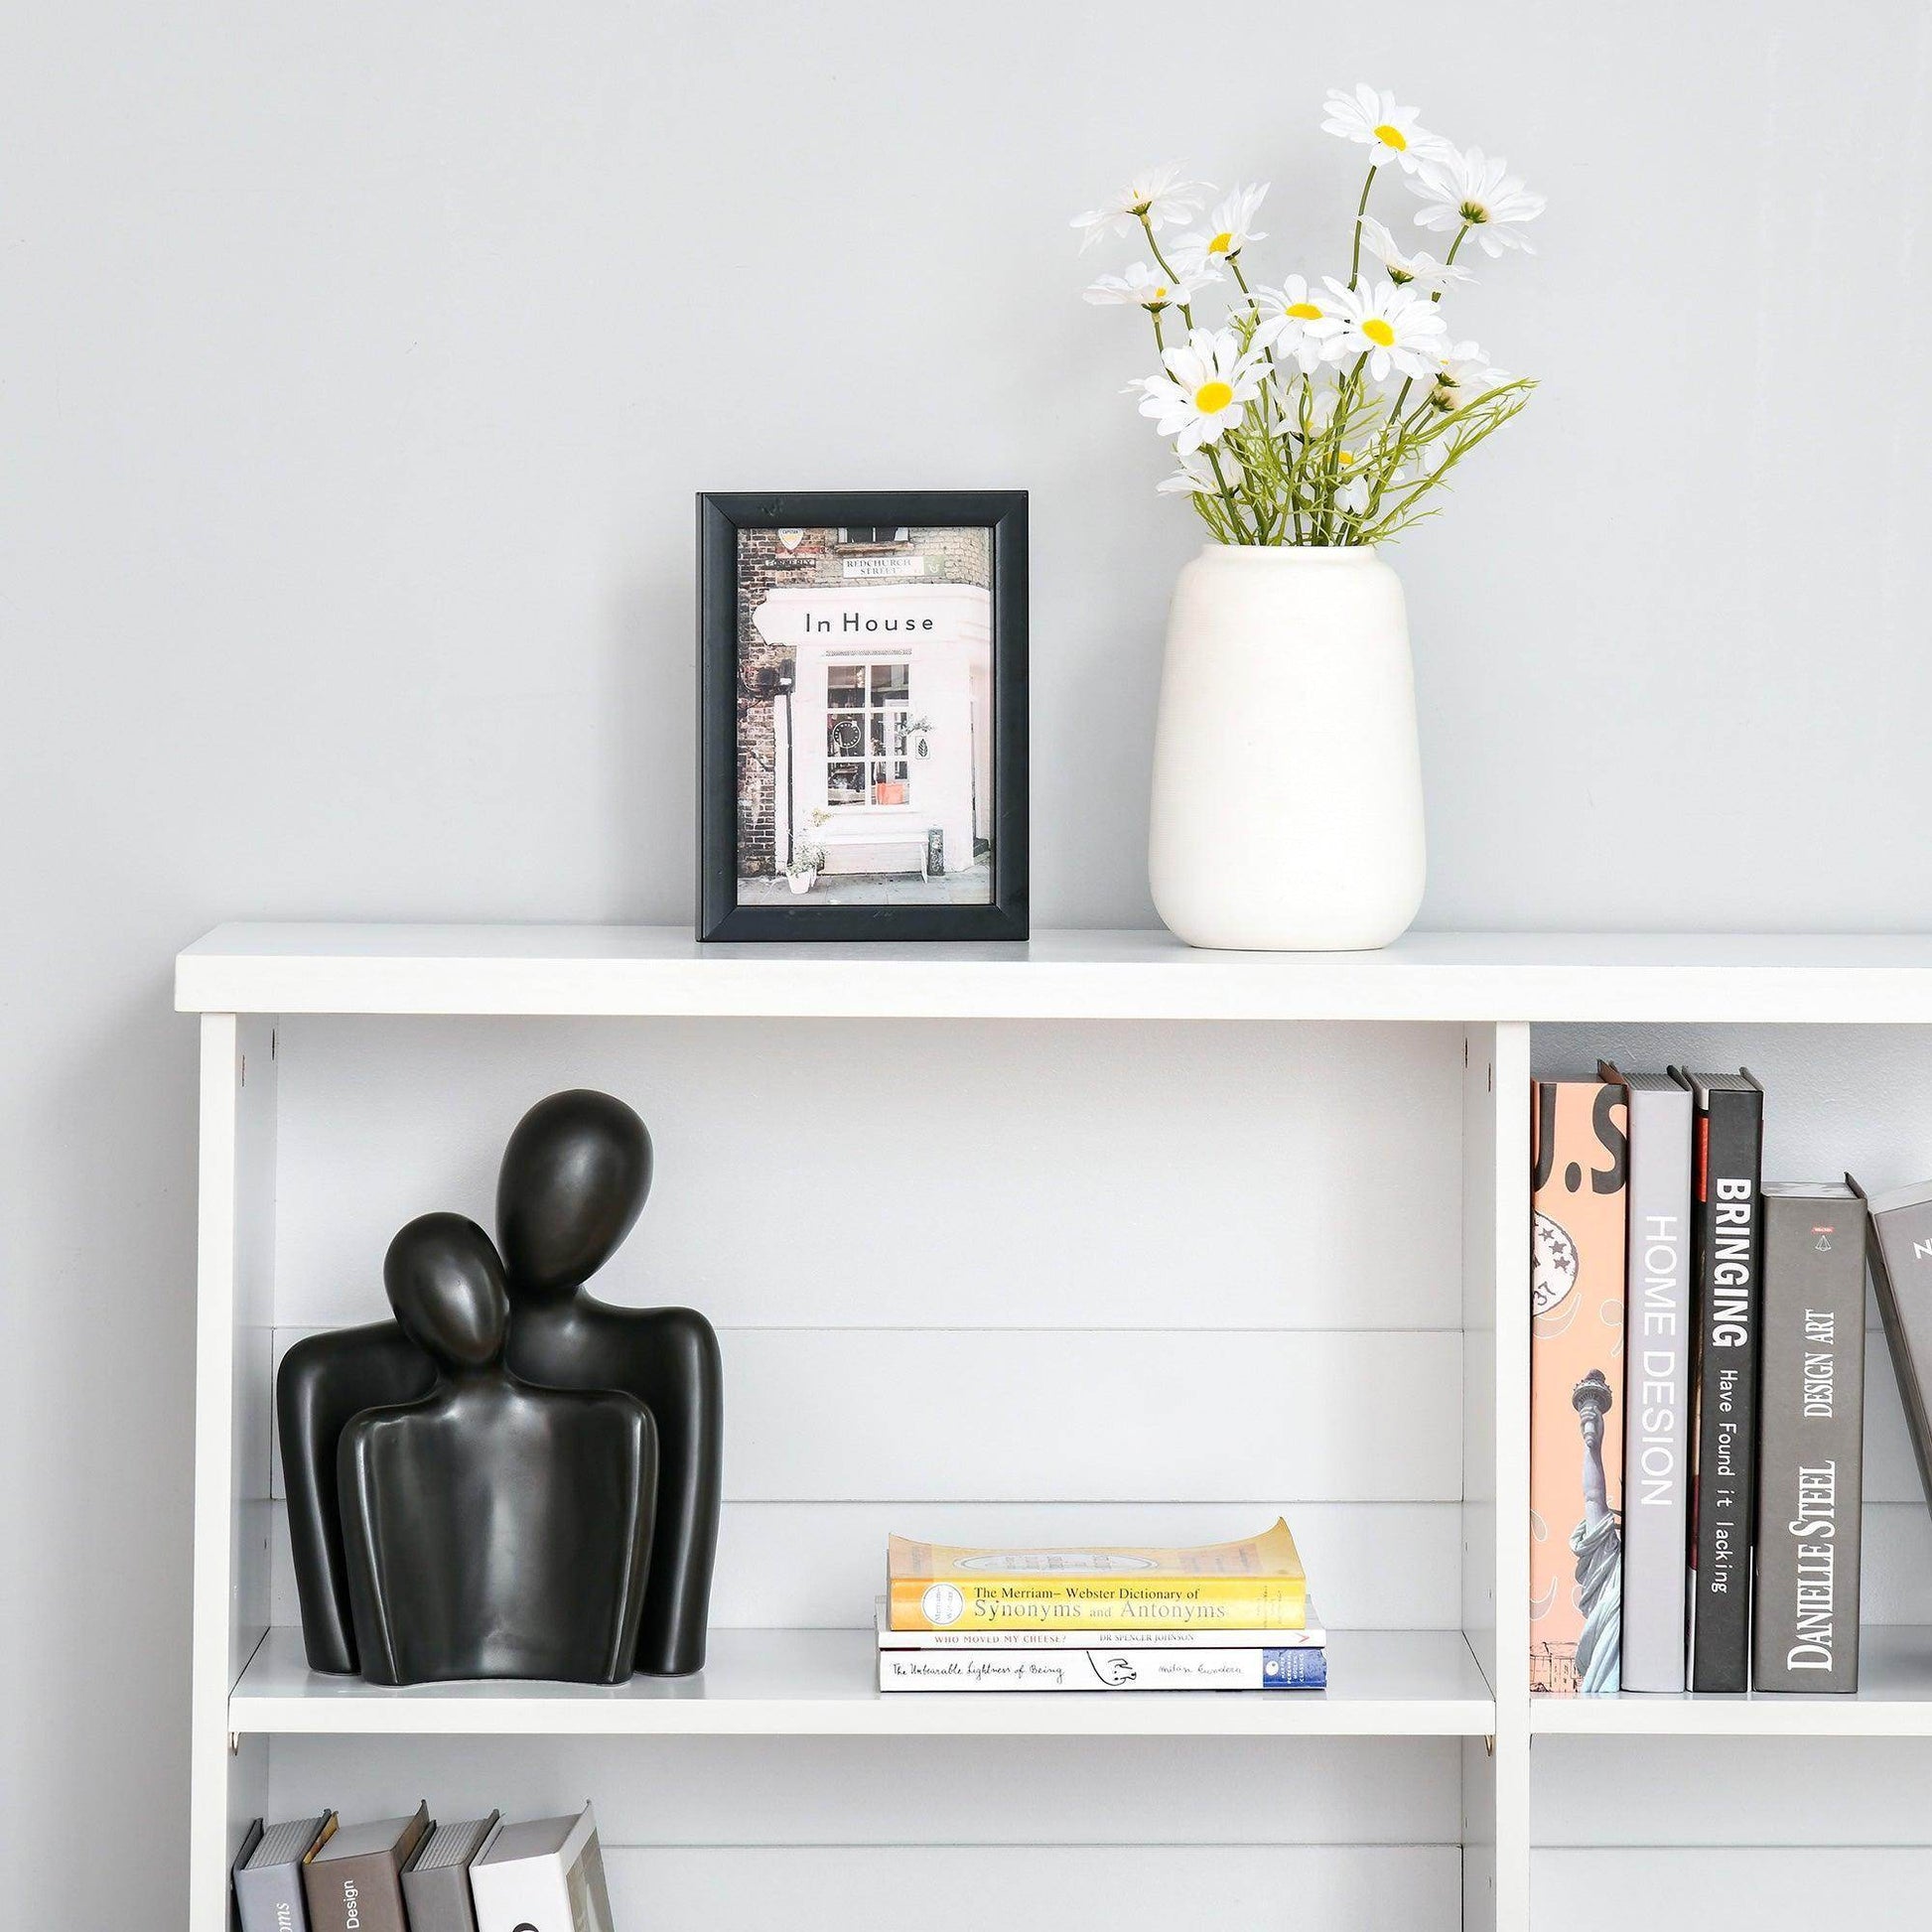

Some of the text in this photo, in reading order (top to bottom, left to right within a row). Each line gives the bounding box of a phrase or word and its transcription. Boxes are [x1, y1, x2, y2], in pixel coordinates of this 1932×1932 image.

[847, 559, 911, 568] REDCHURCH
[806, 613, 933, 631] In House
[1713, 1177, 1752, 1347] BRINGING
[1641, 1215, 1678, 1505] HOME DESION
[1804, 1309, 1835, 1418] DESIGN ART
[1712, 1369, 1738, 1593] Have Found it lacking
[1787, 1459, 1836, 1672] DANIELLE STEEL
[974, 1587, 998, 1598] The
[1065, 1587, 1115, 1598] Webster
[1119, 1587, 1182, 1601] Dictionary
[1186, 1588, 1199, 1599] of
[975, 1598, 1225, 1622] Synonyms and Antonyms
[1155, 1633, 1194, 1643] JOHNSON
[894, 1661, 1065, 1684] The Unbearable Lightness of Being
[343, 1879, 360, 1929] Design
